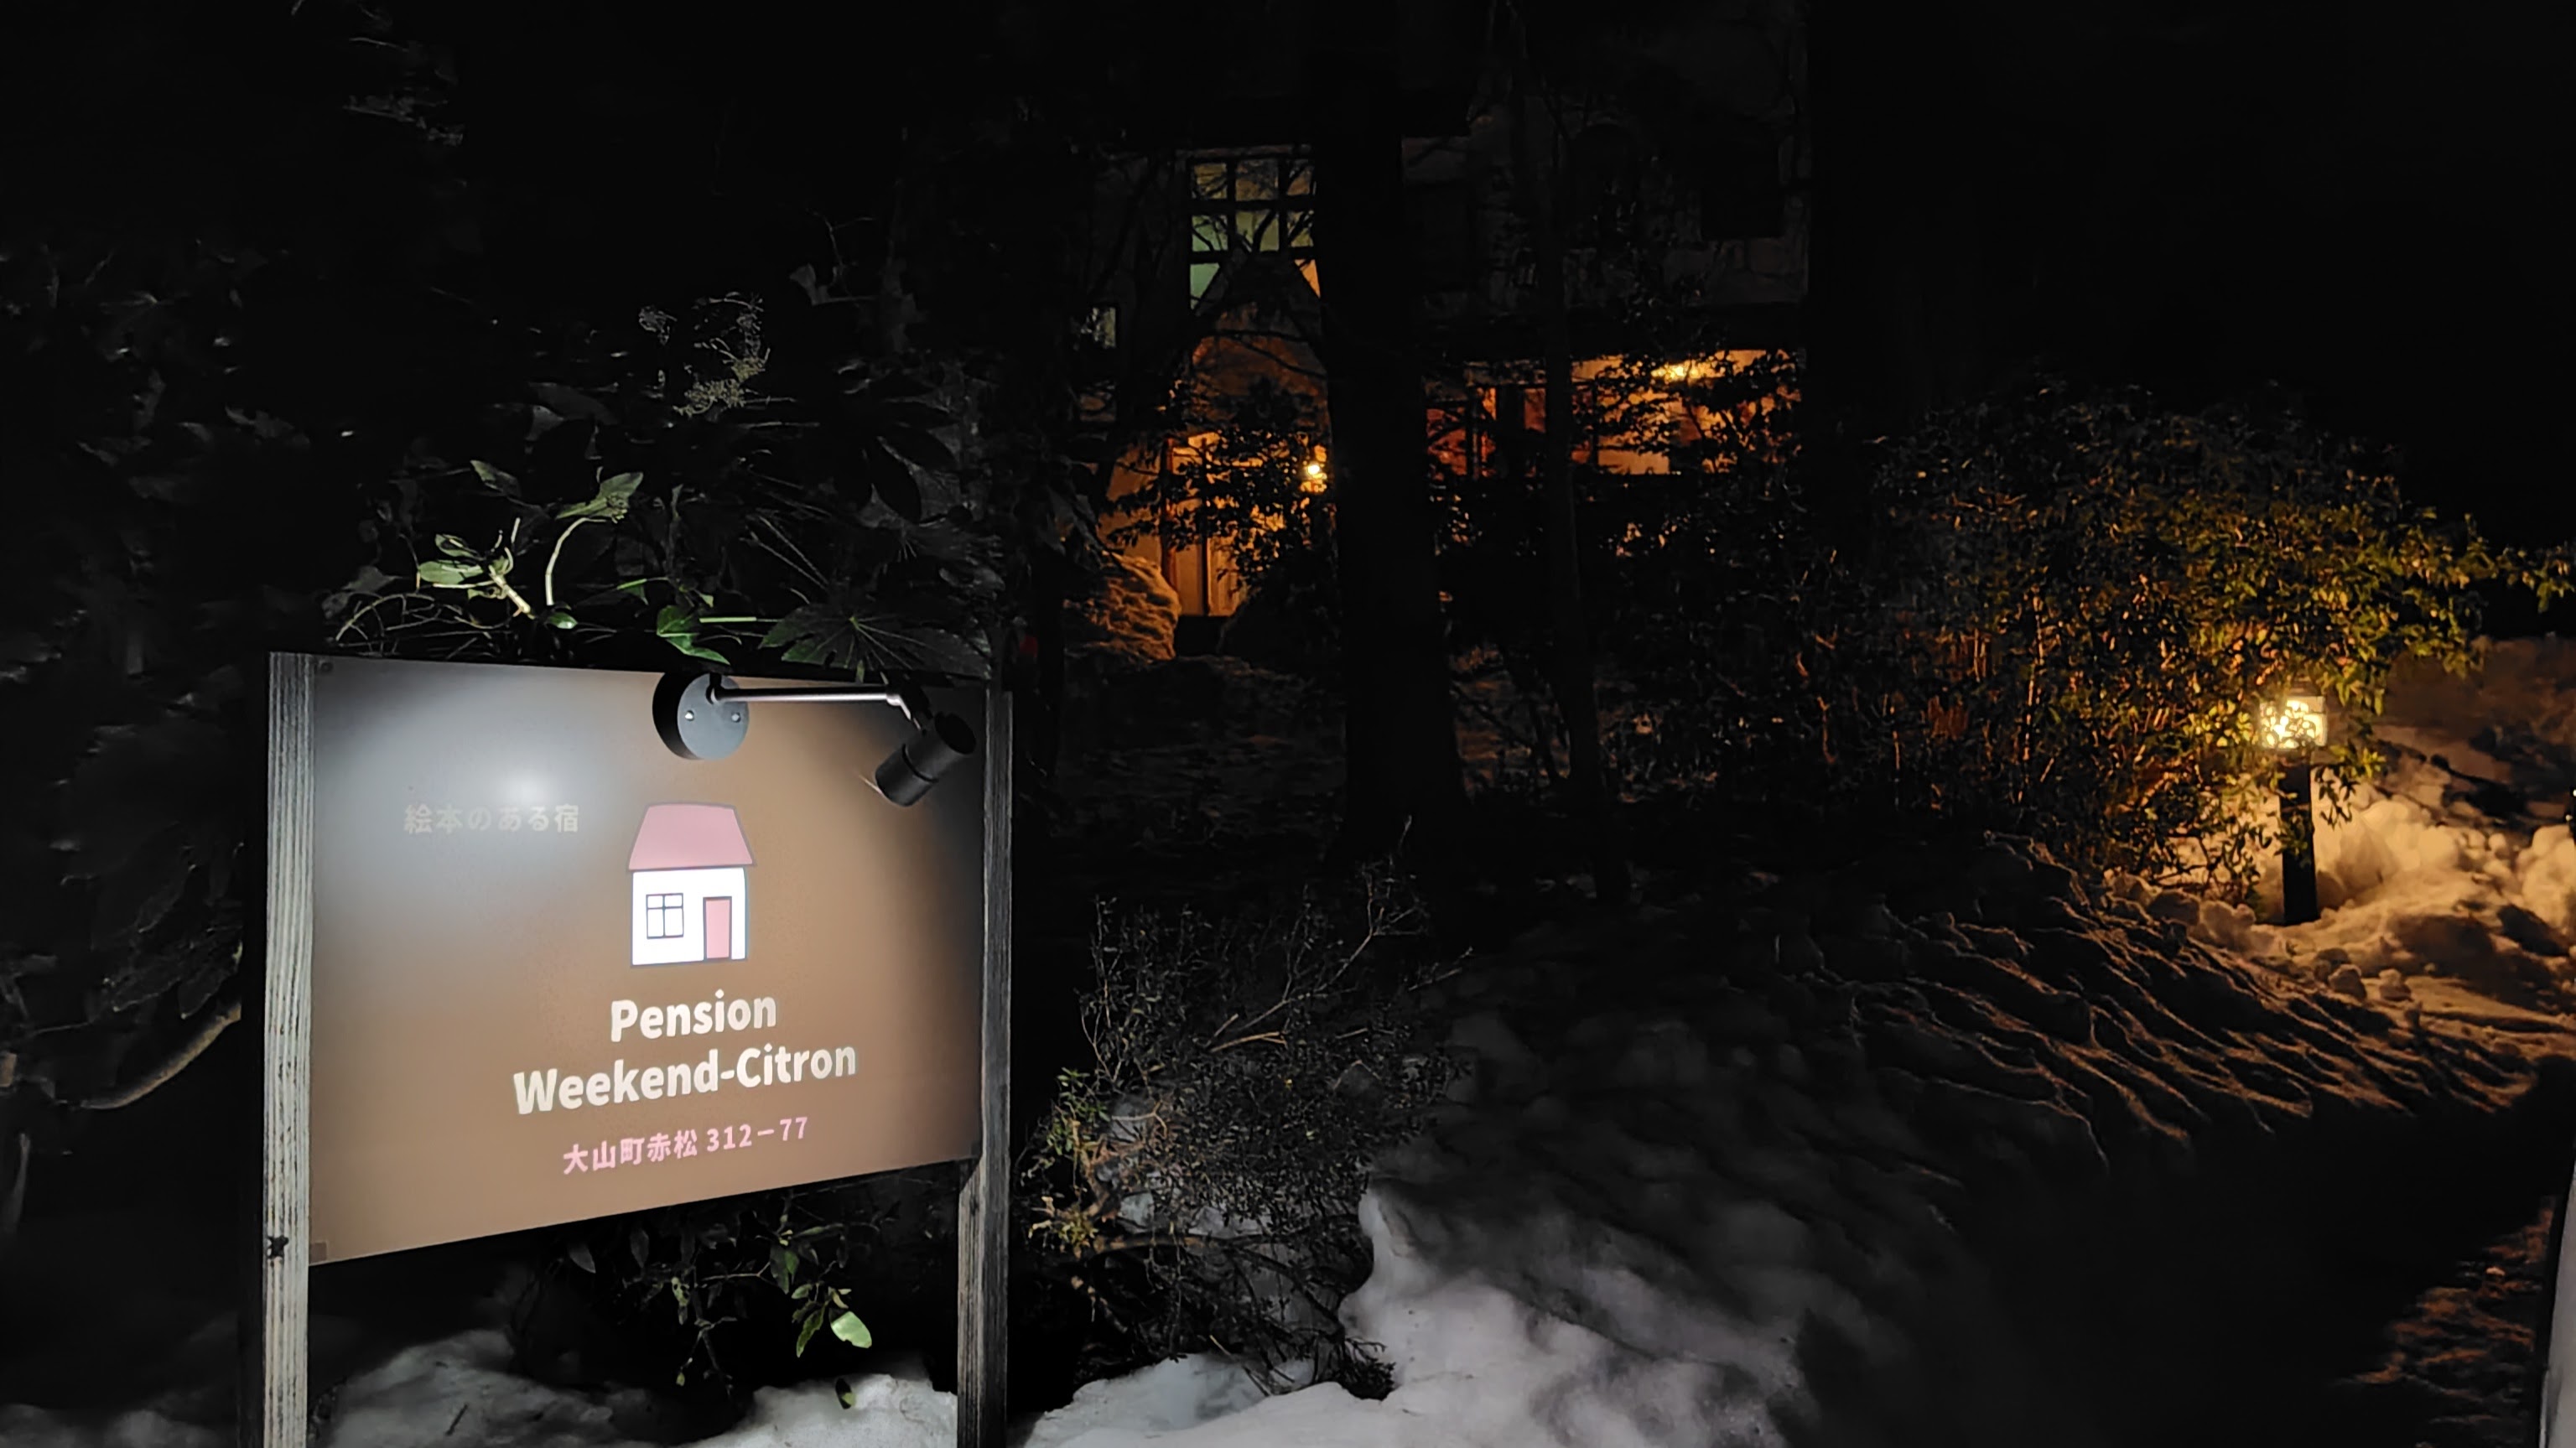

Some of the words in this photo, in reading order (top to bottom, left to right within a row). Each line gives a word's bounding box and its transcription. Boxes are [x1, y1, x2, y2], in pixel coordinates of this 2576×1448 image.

[404, 802, 579, 834] 絵本のある宿
[610, 989, 776, 1042] Pension
[513, 1043, 857, 1115] Weekend-Citron
[563, 1129, 699, 1176] 大山町赤松
